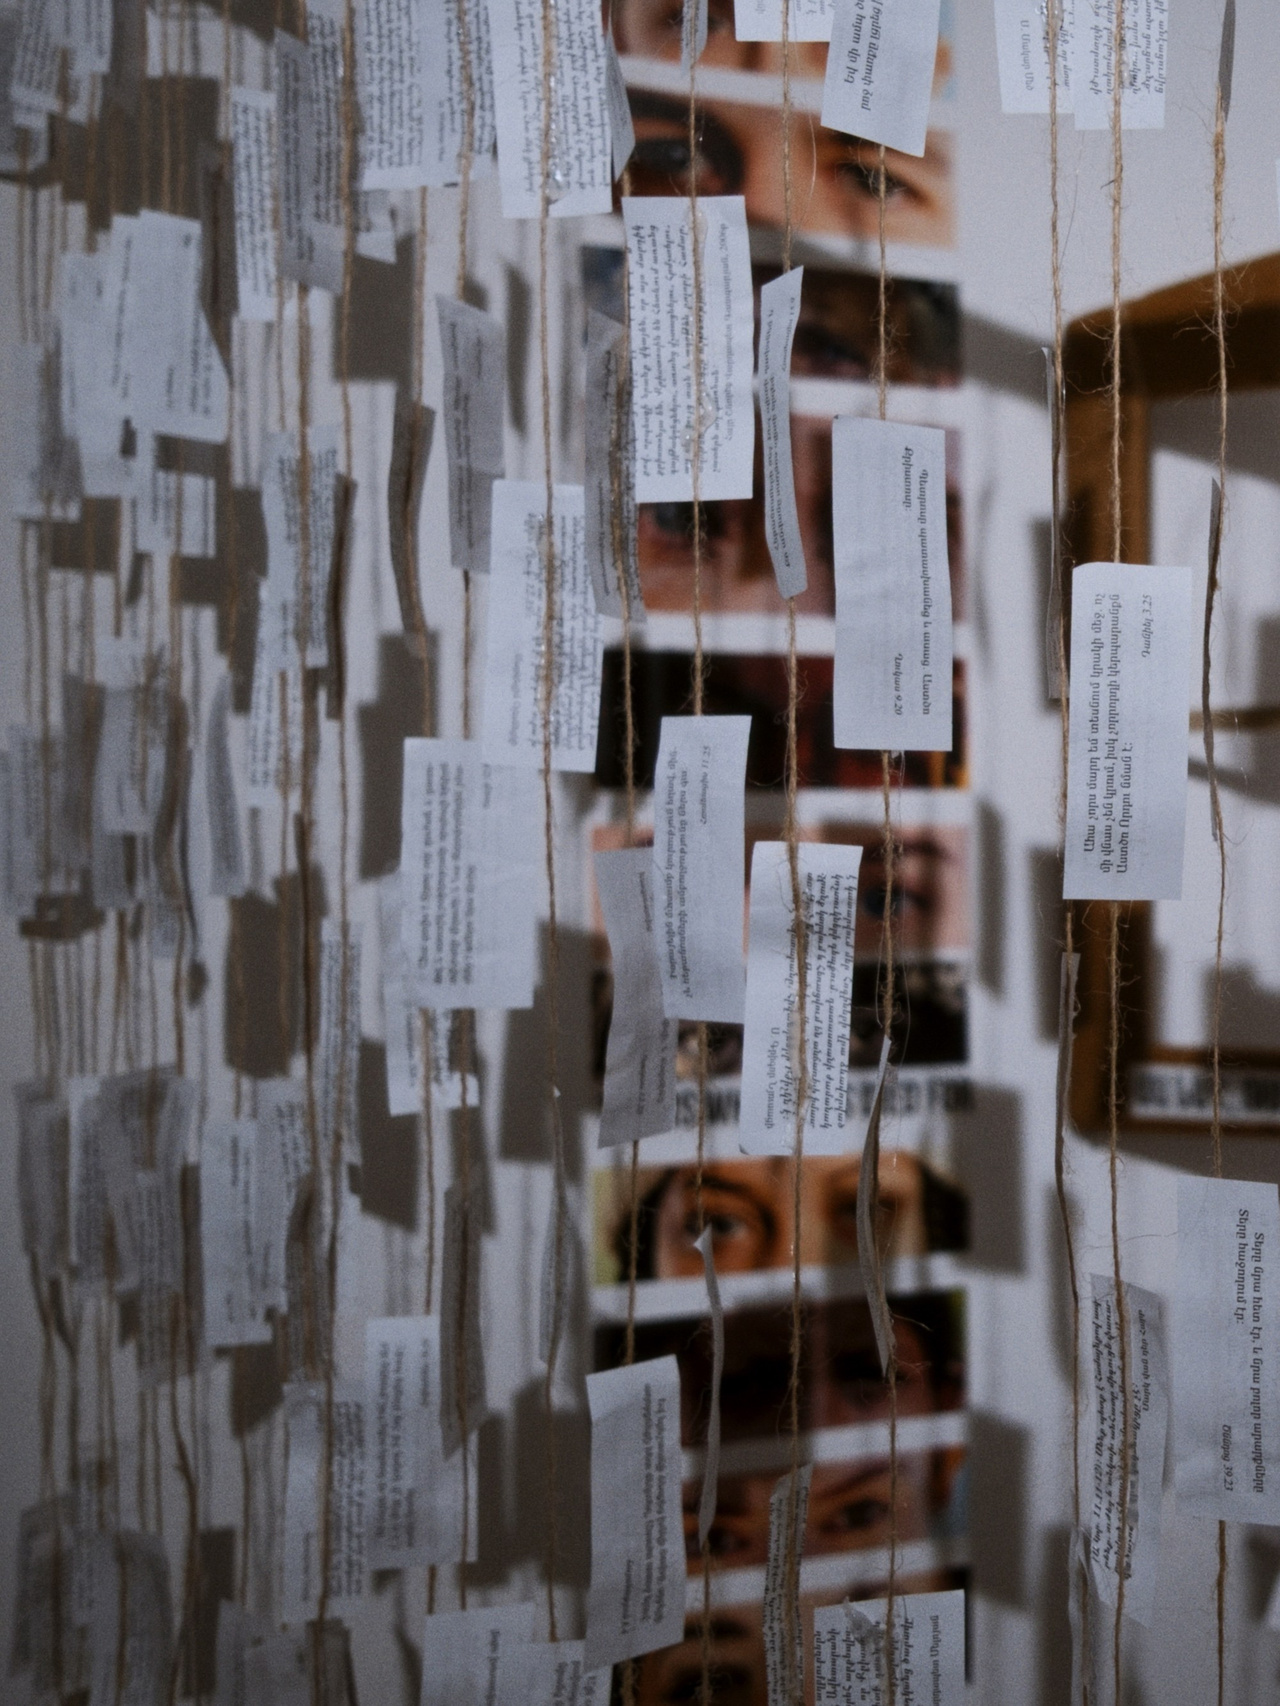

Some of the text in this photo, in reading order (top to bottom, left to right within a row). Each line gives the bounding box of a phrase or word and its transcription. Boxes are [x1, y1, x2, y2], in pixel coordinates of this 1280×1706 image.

[1093, 592, 1106, 605] ոչ
[1089, 637, 1104, 678] կրակի
[1088, 681, 1100, 734] տեսնում
[1086, 737, 1099, 753] եմ
[1098, 593, 1122, 873] մի վնաս չեն կրում, իսկ չորրորդի կերպարանքն
[1085, 756, 1101, 790] մարդ
[1087, 793, 1099, 821] չորս
[1115, 755, 1133, 874] Աստծո Որդու նման
[1082, 823, 1096, 852] Ահա
[1232, 1208, 1249, 1324] Տերը հաջողում էր։
[1248, 1231, 1266, 1493] Տերը նրա հետ էր, նրա բոլոր արարքները
